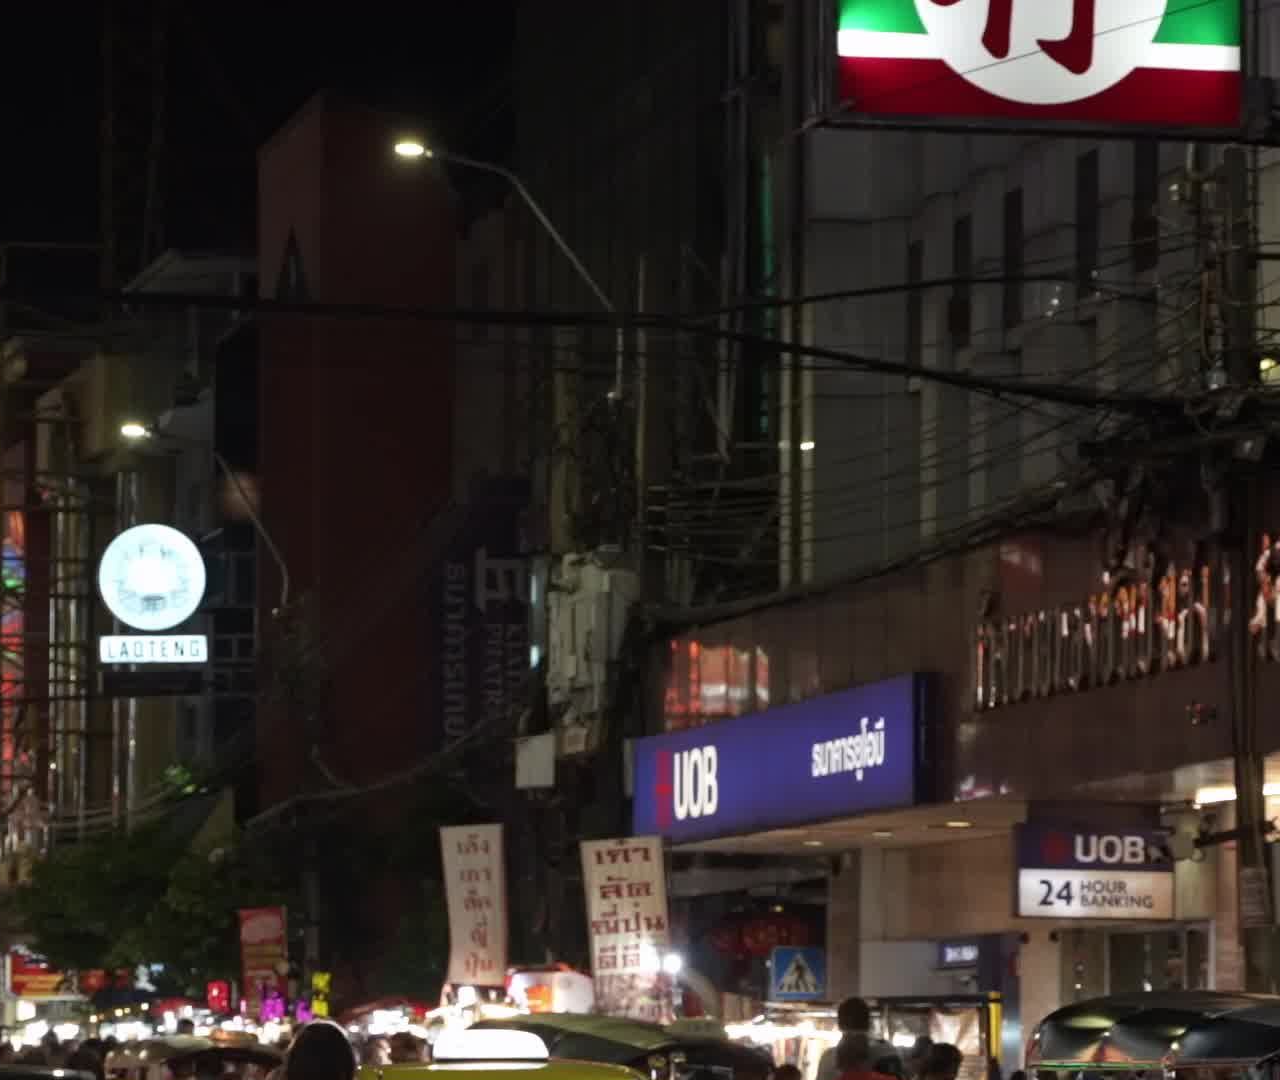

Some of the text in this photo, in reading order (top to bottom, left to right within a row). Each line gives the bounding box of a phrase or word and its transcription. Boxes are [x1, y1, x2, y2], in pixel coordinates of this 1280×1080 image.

[107, 639, 200, 658] LAOTENG
[811, 716, 885, 781] ธนาคารยูโอบี
[674, 745, 718, 820] UOB
[1074, 834, 1145, 864] UOB
[1039, 879, 1074, 906] 24
[1080, 880, 1127, 895] HOUR
[1080, 895, 1153, 909] BANKING
